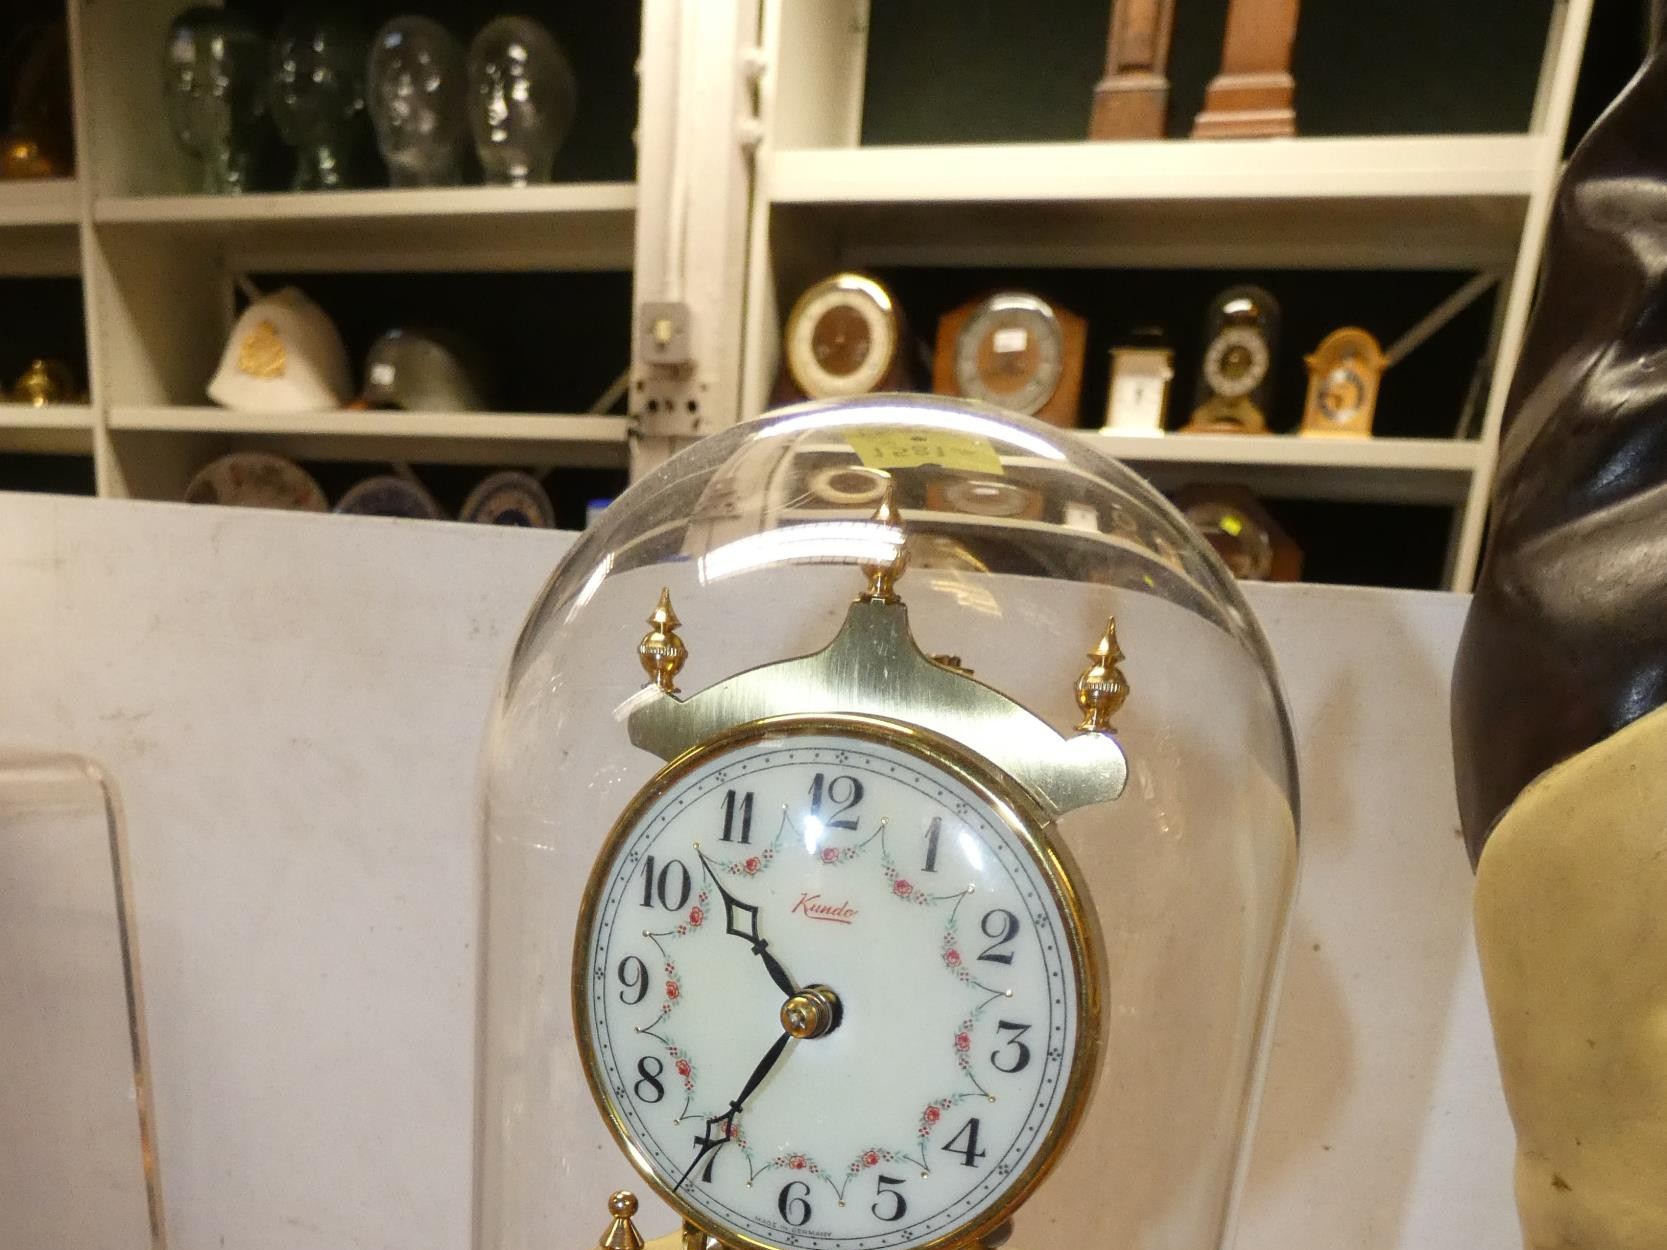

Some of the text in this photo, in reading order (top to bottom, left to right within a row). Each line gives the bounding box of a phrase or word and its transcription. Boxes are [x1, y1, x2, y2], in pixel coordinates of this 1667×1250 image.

[718, 789, 756, 845] 11
[807, 772, 864, 832] 12
[918, 815, 944, 874] 1
[639, 855, 692, 912] 10
[977, 908, 1020, 966] 2
[617, 955, 649, 1005] 9
[990, 1020, 1032, 1074] 3
[633, 1055, 664, 1103] 8
[693, 1135, 725, 1184] 7
[941, 1117, 987, 1168] 4
[755, 1215, 777, 1229] MADE
[777, 1180, 812, 1227] 6
[871, 1174, 908, 1222] 5
